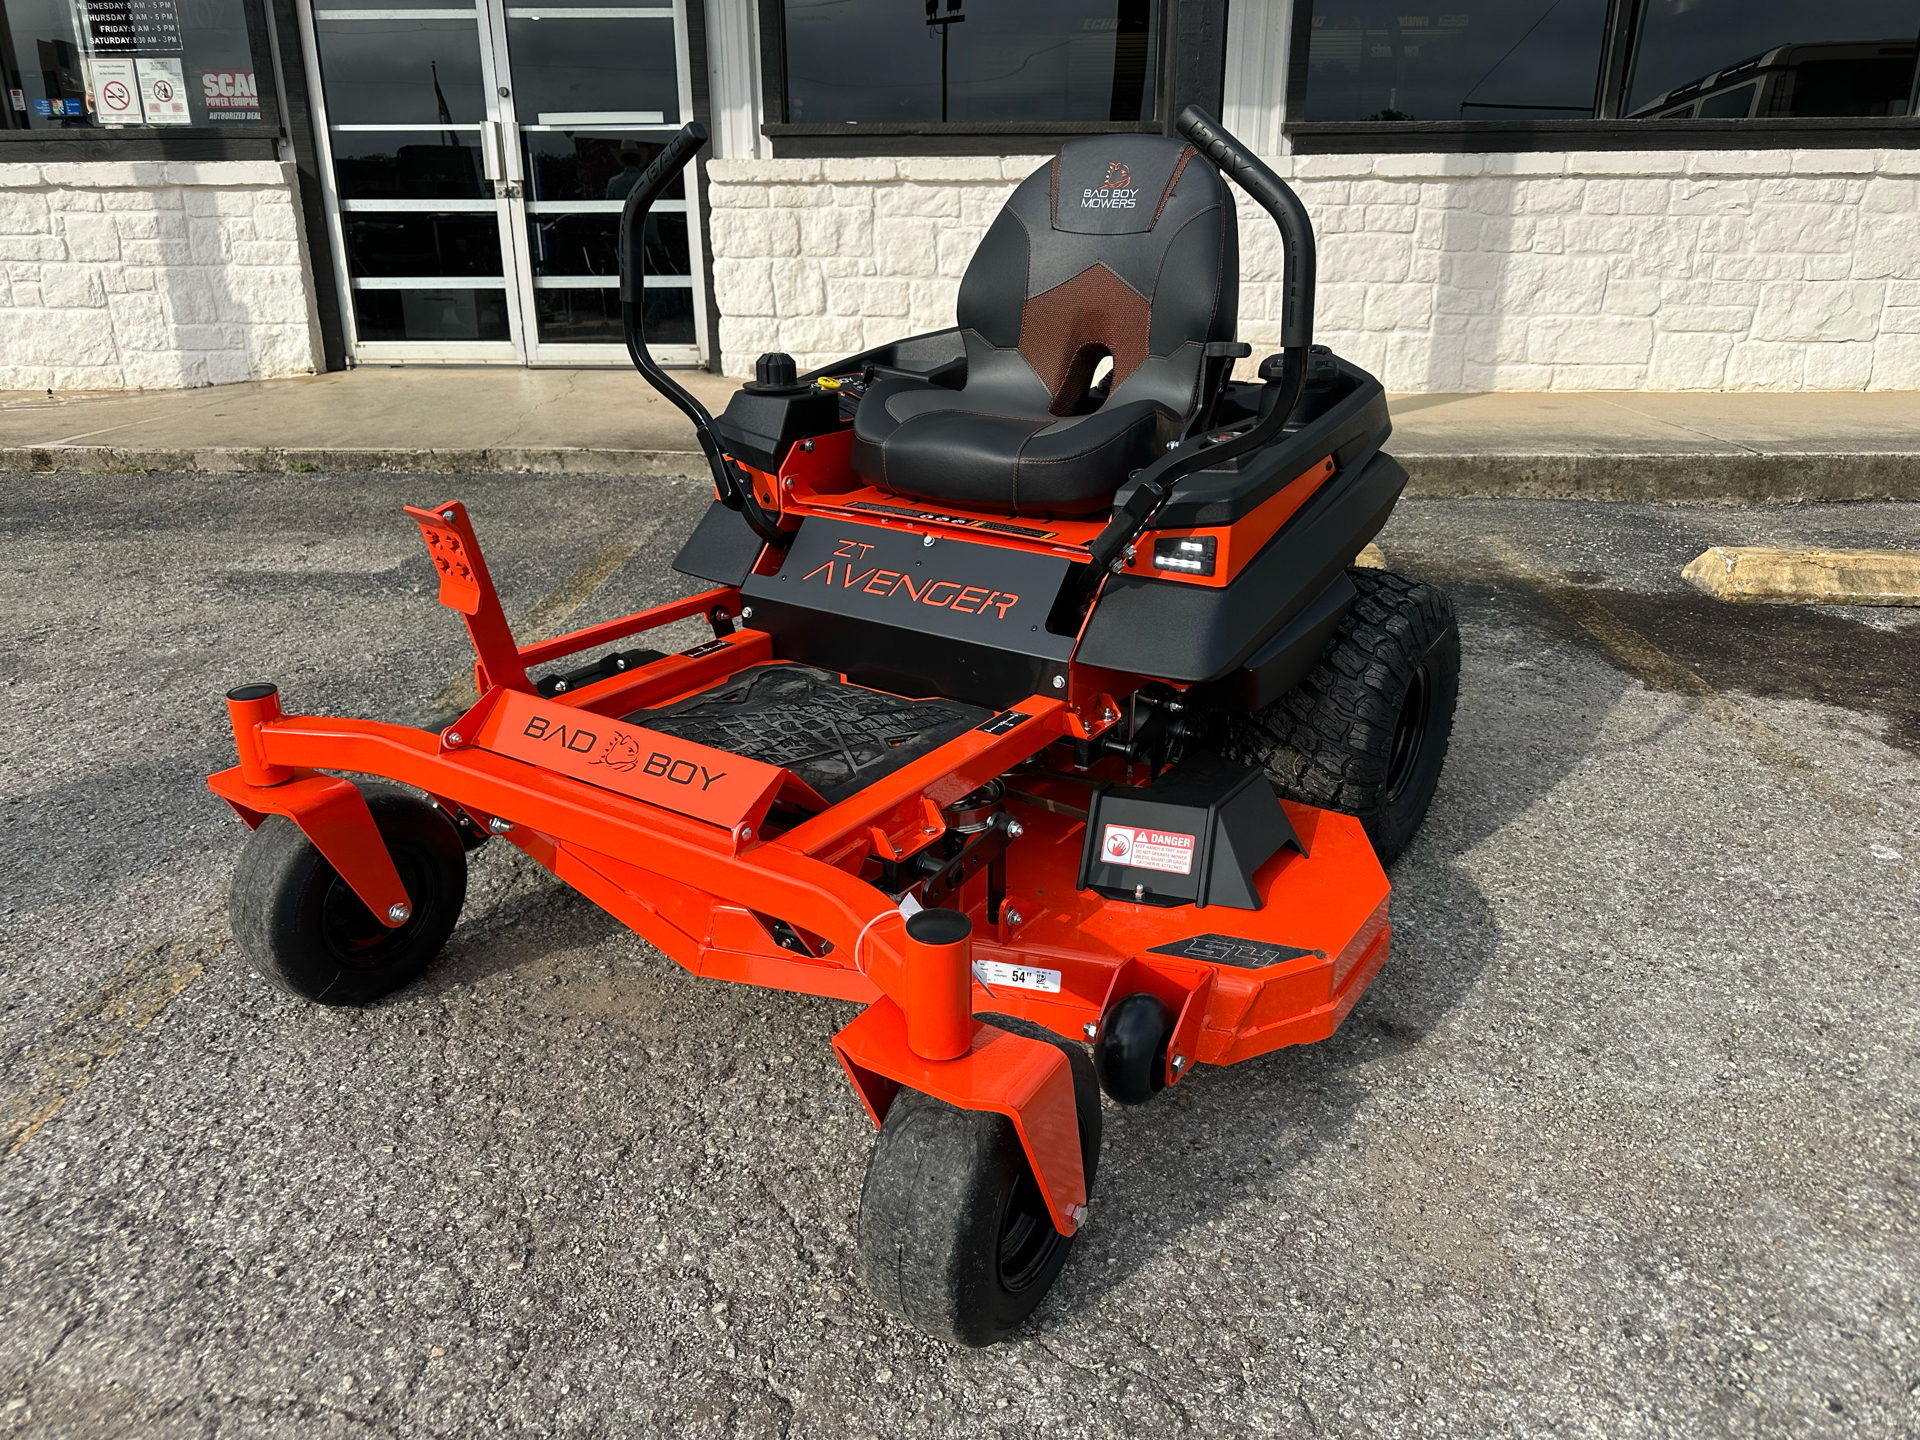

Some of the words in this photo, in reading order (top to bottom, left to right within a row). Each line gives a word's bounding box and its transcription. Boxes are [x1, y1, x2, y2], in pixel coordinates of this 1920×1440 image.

[134, 1, 146, 9] AM
[153, 1, 157, 9] 5
[159, 1, 171, 9] PM
[100, 25, 131, 33] FRIDAY:
[89, 37, 132, 45] SATURDAY:
[133, 36, 146, 44] 8:30
[205, 97, 230, 107] POWER
[209, 111, 246, 120] AUTHORIZED
[1083, 188, 1109, 198] BAD
[1112, 188, 1139, 198] BOY
[1080, 198, 1136, 209] MOWERS
[832, 539, 875, 559] ZT
[802, 560, 1019, 619] AVENGER
[523, 716, 597, 753] BAD
[643, 752, 727, 791] BOY
[1151, 833, 1191, 848] DANGER
[1012, 970, 1032, 983] 54"
